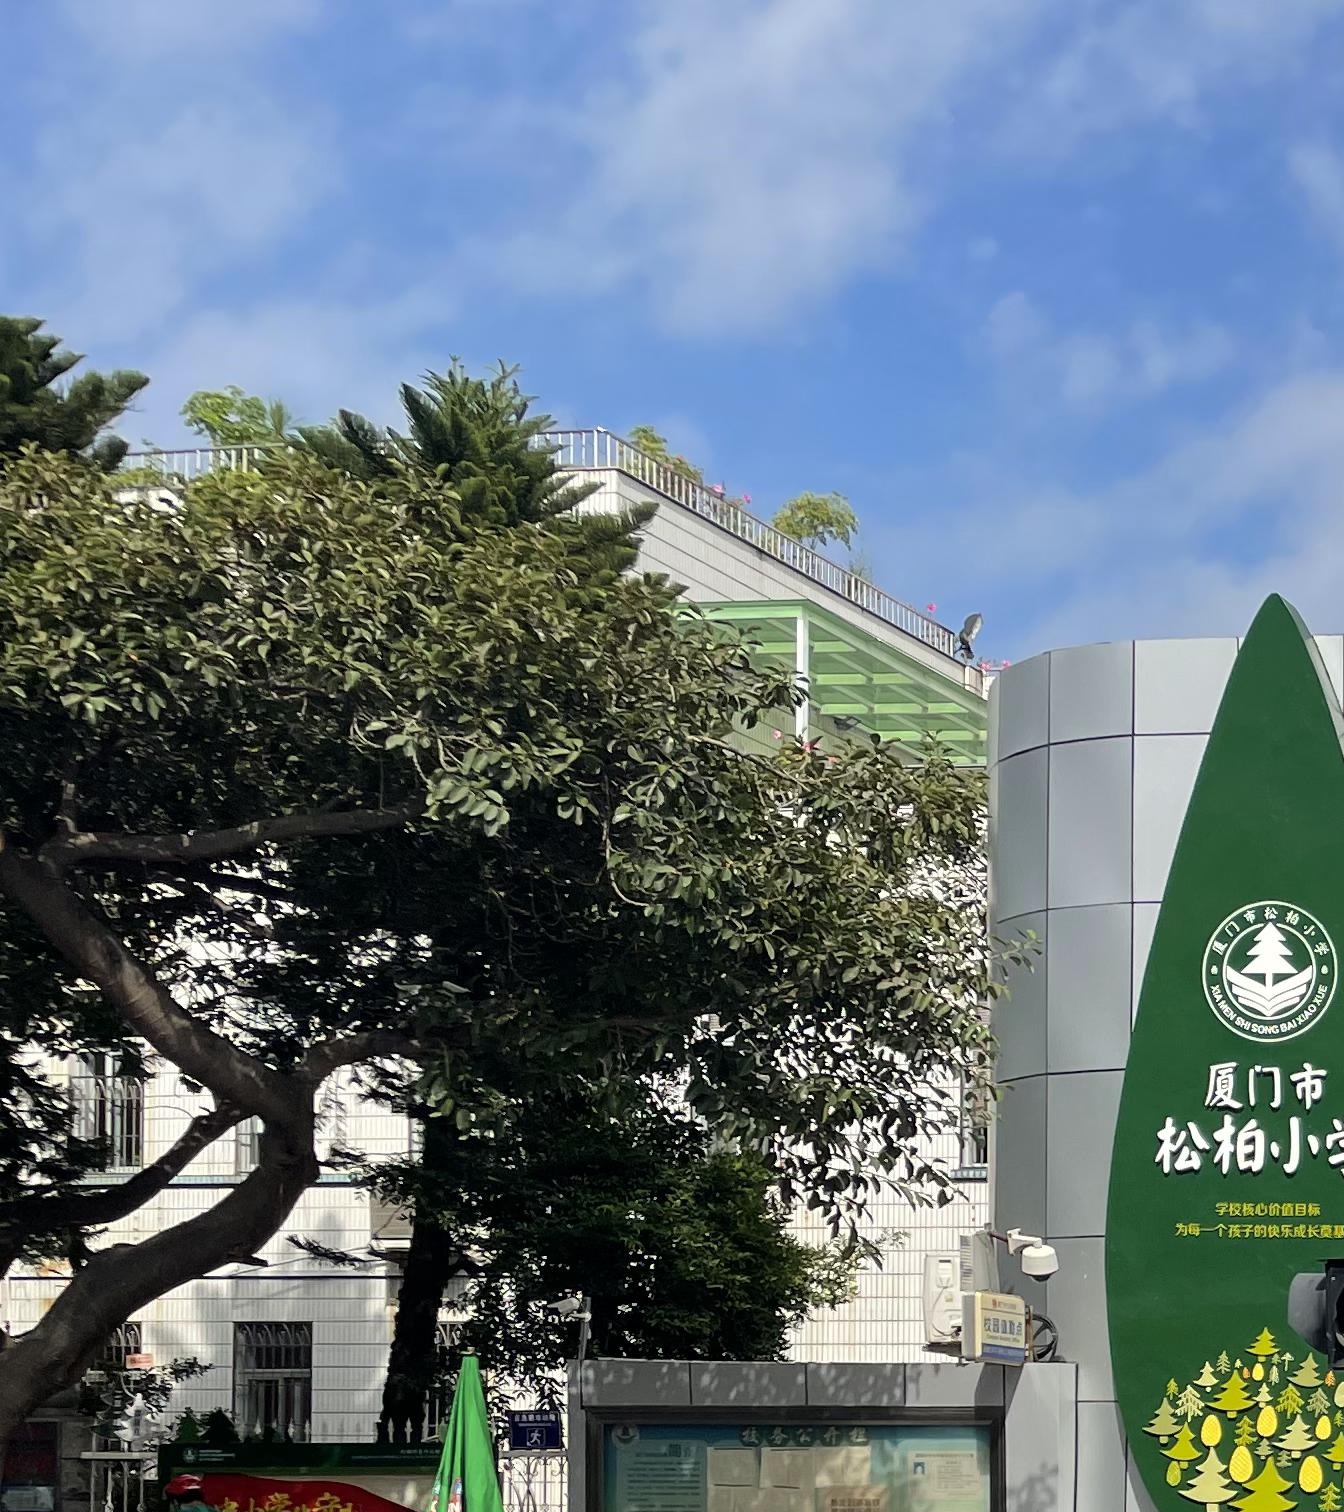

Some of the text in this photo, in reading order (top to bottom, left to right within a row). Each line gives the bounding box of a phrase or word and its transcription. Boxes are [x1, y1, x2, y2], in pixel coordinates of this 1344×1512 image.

[1211, 906, 1331, 957] 厦门市松柏小学
[1209, 983, 1328, 1035] XIA MEN SHI SONG BAI XIAO XUE
[1203, 1061, 1328, 1111] 厦门市
[1215, 1201, 1321, 1217] 学校核心价值目标
